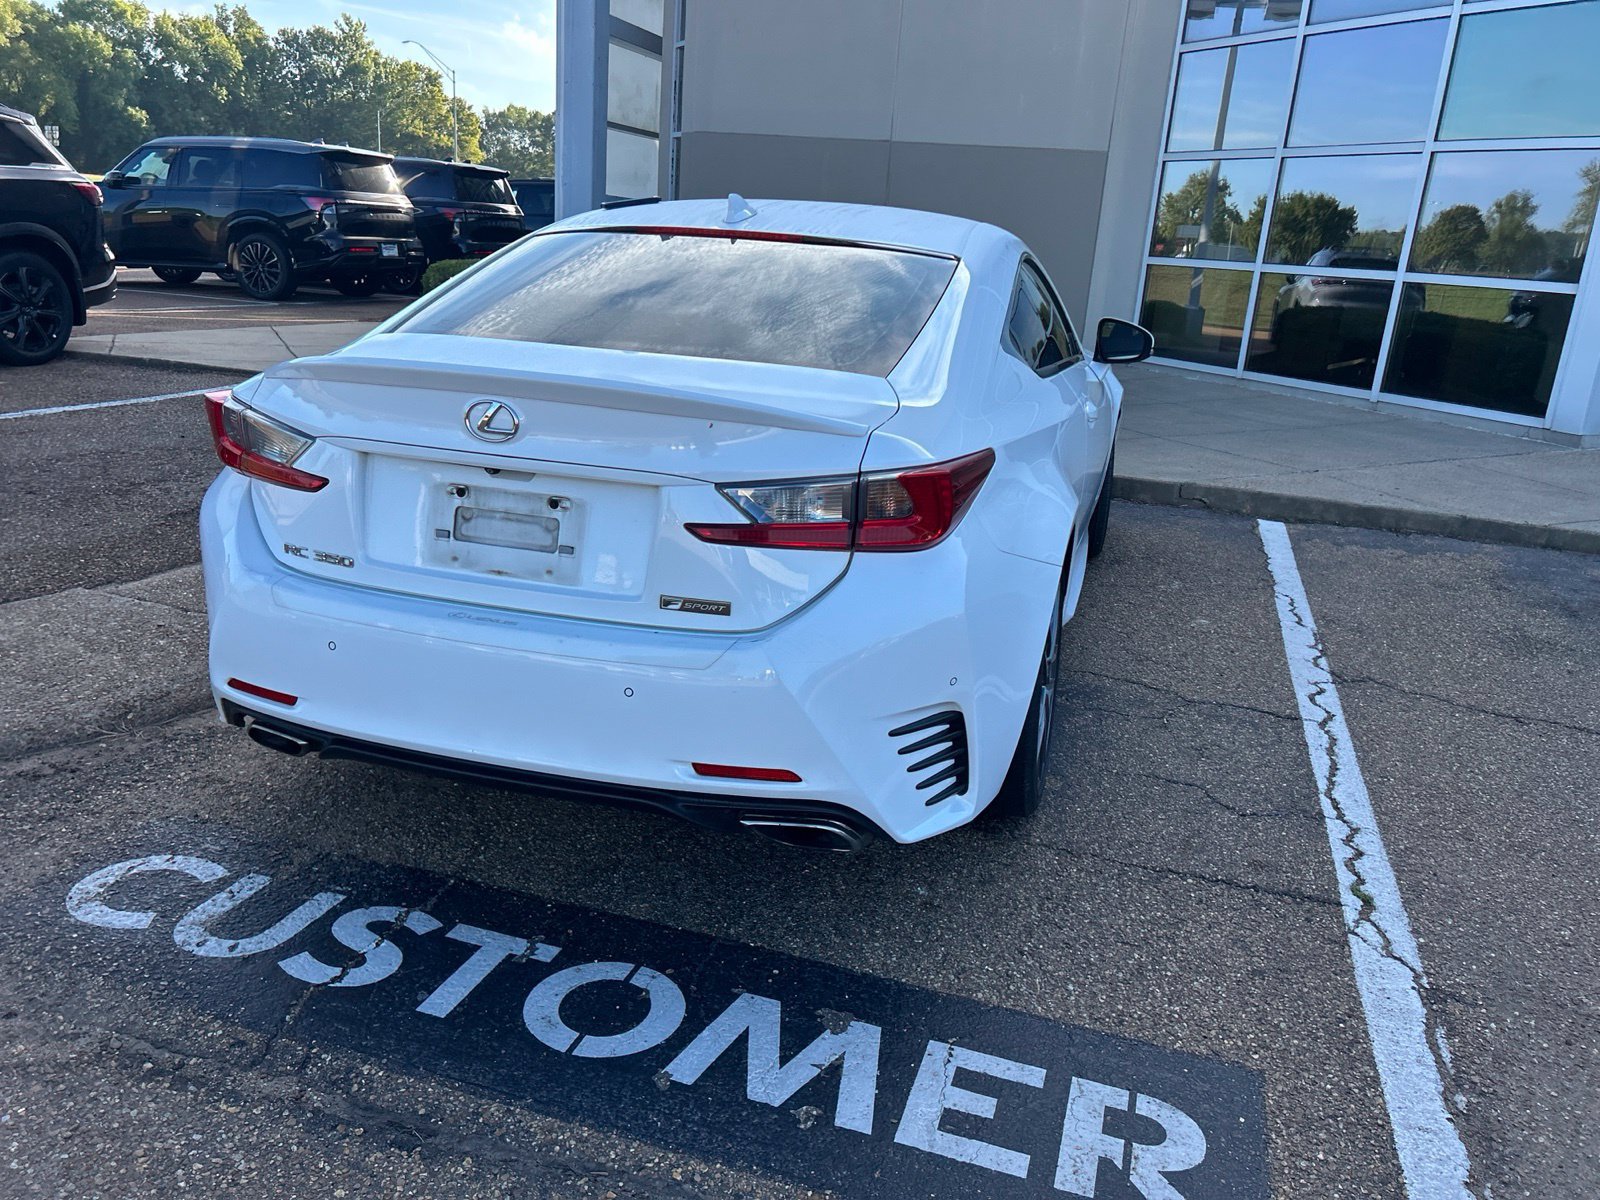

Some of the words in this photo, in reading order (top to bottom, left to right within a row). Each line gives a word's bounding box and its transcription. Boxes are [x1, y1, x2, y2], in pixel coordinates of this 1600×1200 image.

[283, 543, 309, 559] RC
[312, 550, 355, 568] 350
[683, 602, 727, 612] SPORT
[65, 854, 1207, 1200] CUSTOMER
